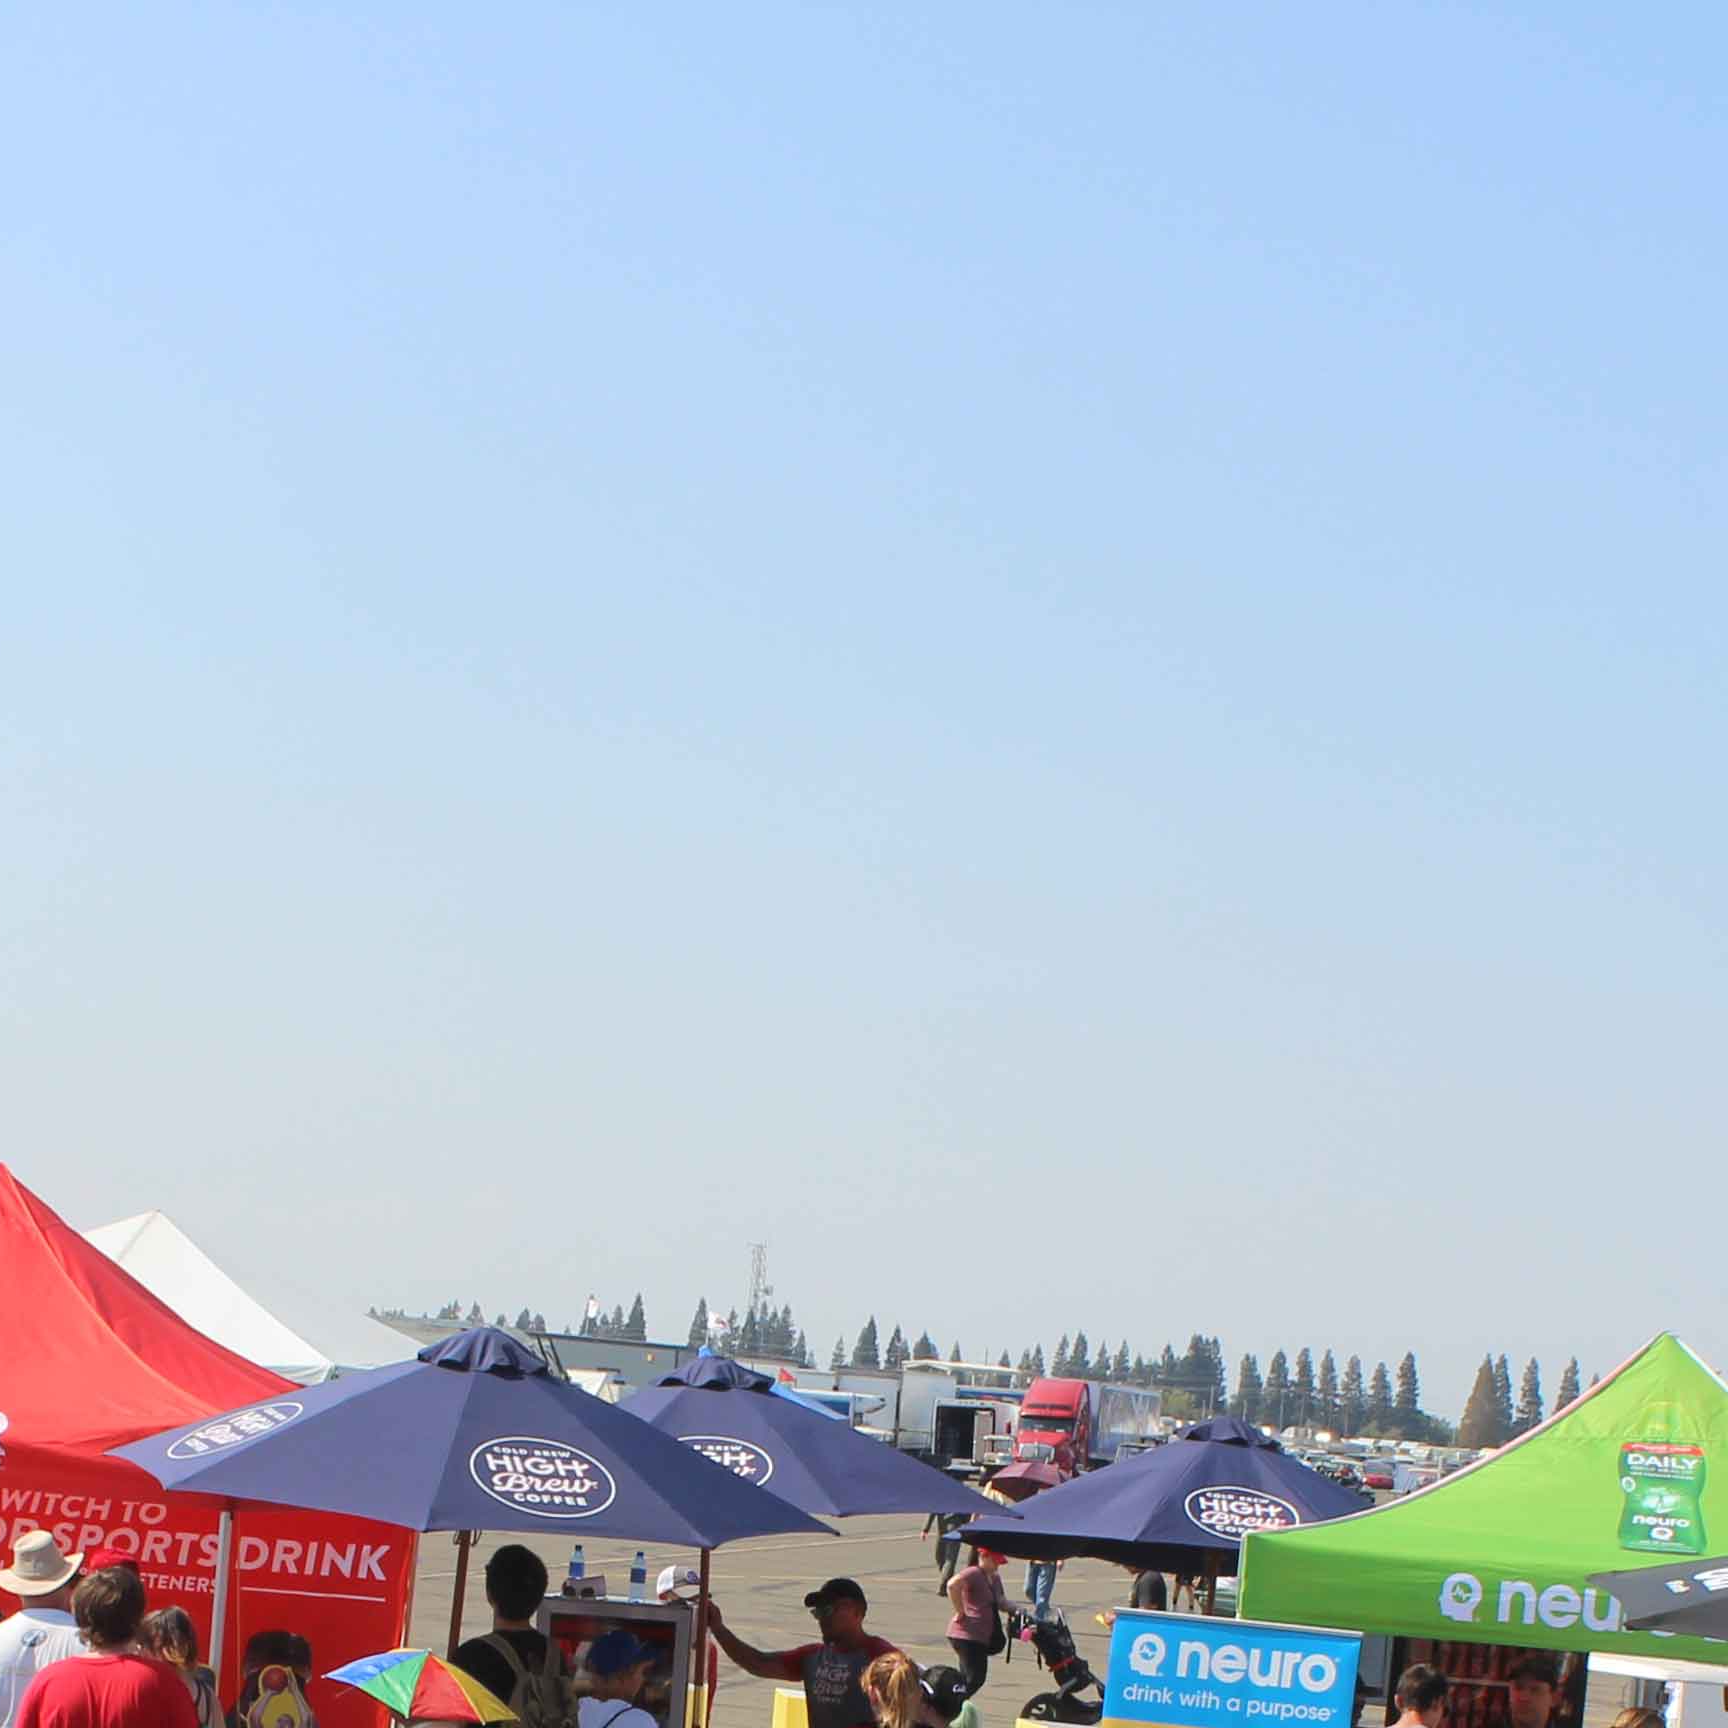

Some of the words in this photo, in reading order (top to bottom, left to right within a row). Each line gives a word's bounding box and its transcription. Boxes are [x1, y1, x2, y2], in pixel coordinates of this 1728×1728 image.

[493, 1446, 528, 1456] COLD
[533, 1448, 571, 1458] BREW
[1627, 1453, 1699, 1469] DAILY
[485, 1453, 590, 1477] HIGH
[491, 1472, 599, 1494] Brew
[513, 1493, 588, 1507] COFFEE
[1199, 1496, 1283, 1517] HIGH
[120, 1500, 168, 1526] TO
[1632, 1515, 1690, 1527] neuro
[53, 1524, 220, 1567] SPORTS
[235, 1536, 391, 1582] DRINK
[1496, 1579, 1624, 1632] neu
[1176, 1641, 1336, 1693] neuro
[1123, 1684, 1173, 1704] drink
[1180, 1691, 1219, 1711] with
[1226, 1698, 1241, 1712] a
[1246, 1701, 1331, 1722] purpose
